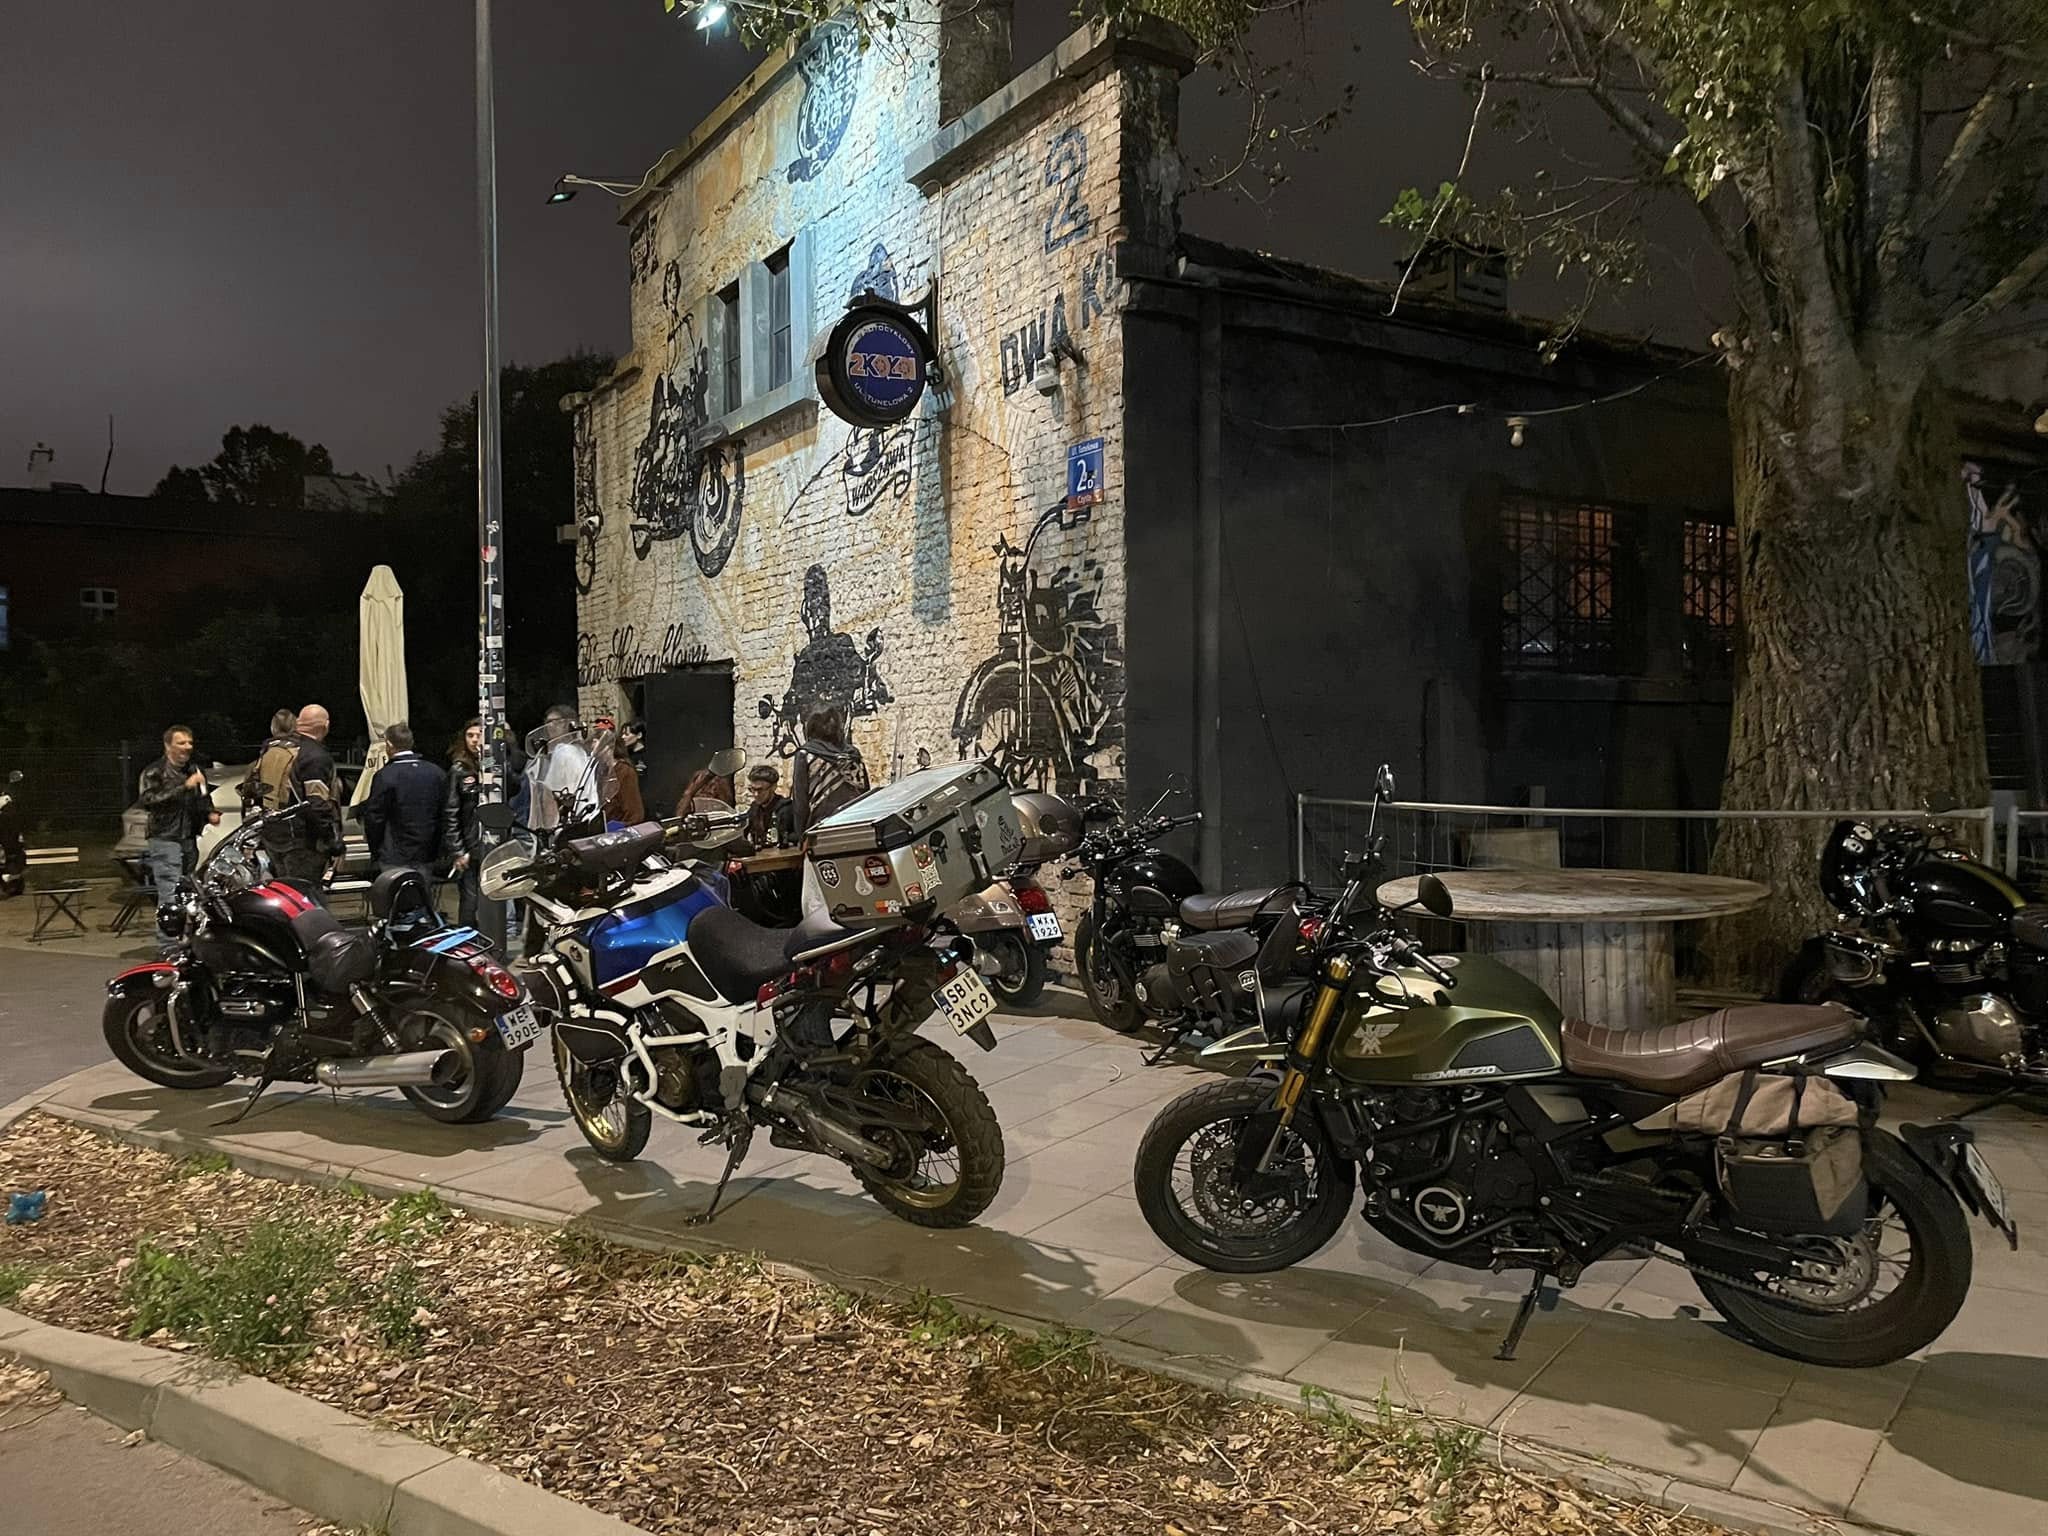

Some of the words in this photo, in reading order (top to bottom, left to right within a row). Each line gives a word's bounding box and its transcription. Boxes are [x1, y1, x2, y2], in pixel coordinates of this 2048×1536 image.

[1045, 126, 1089, 255] 2
[1000, 287, 1070, 397] DWA
[867, 393, 910, 407] TUNELOWA
[851, 442, 907, 507] WARSZAWA
[577, 632, 605, 687] Bar
[1035, 926, 1058, 938] 1929
[946, 978, 974, 1004] SBI
[952, 992, 989, 1029] 3NC9
[507, 1021, 539, 1046] 390E
